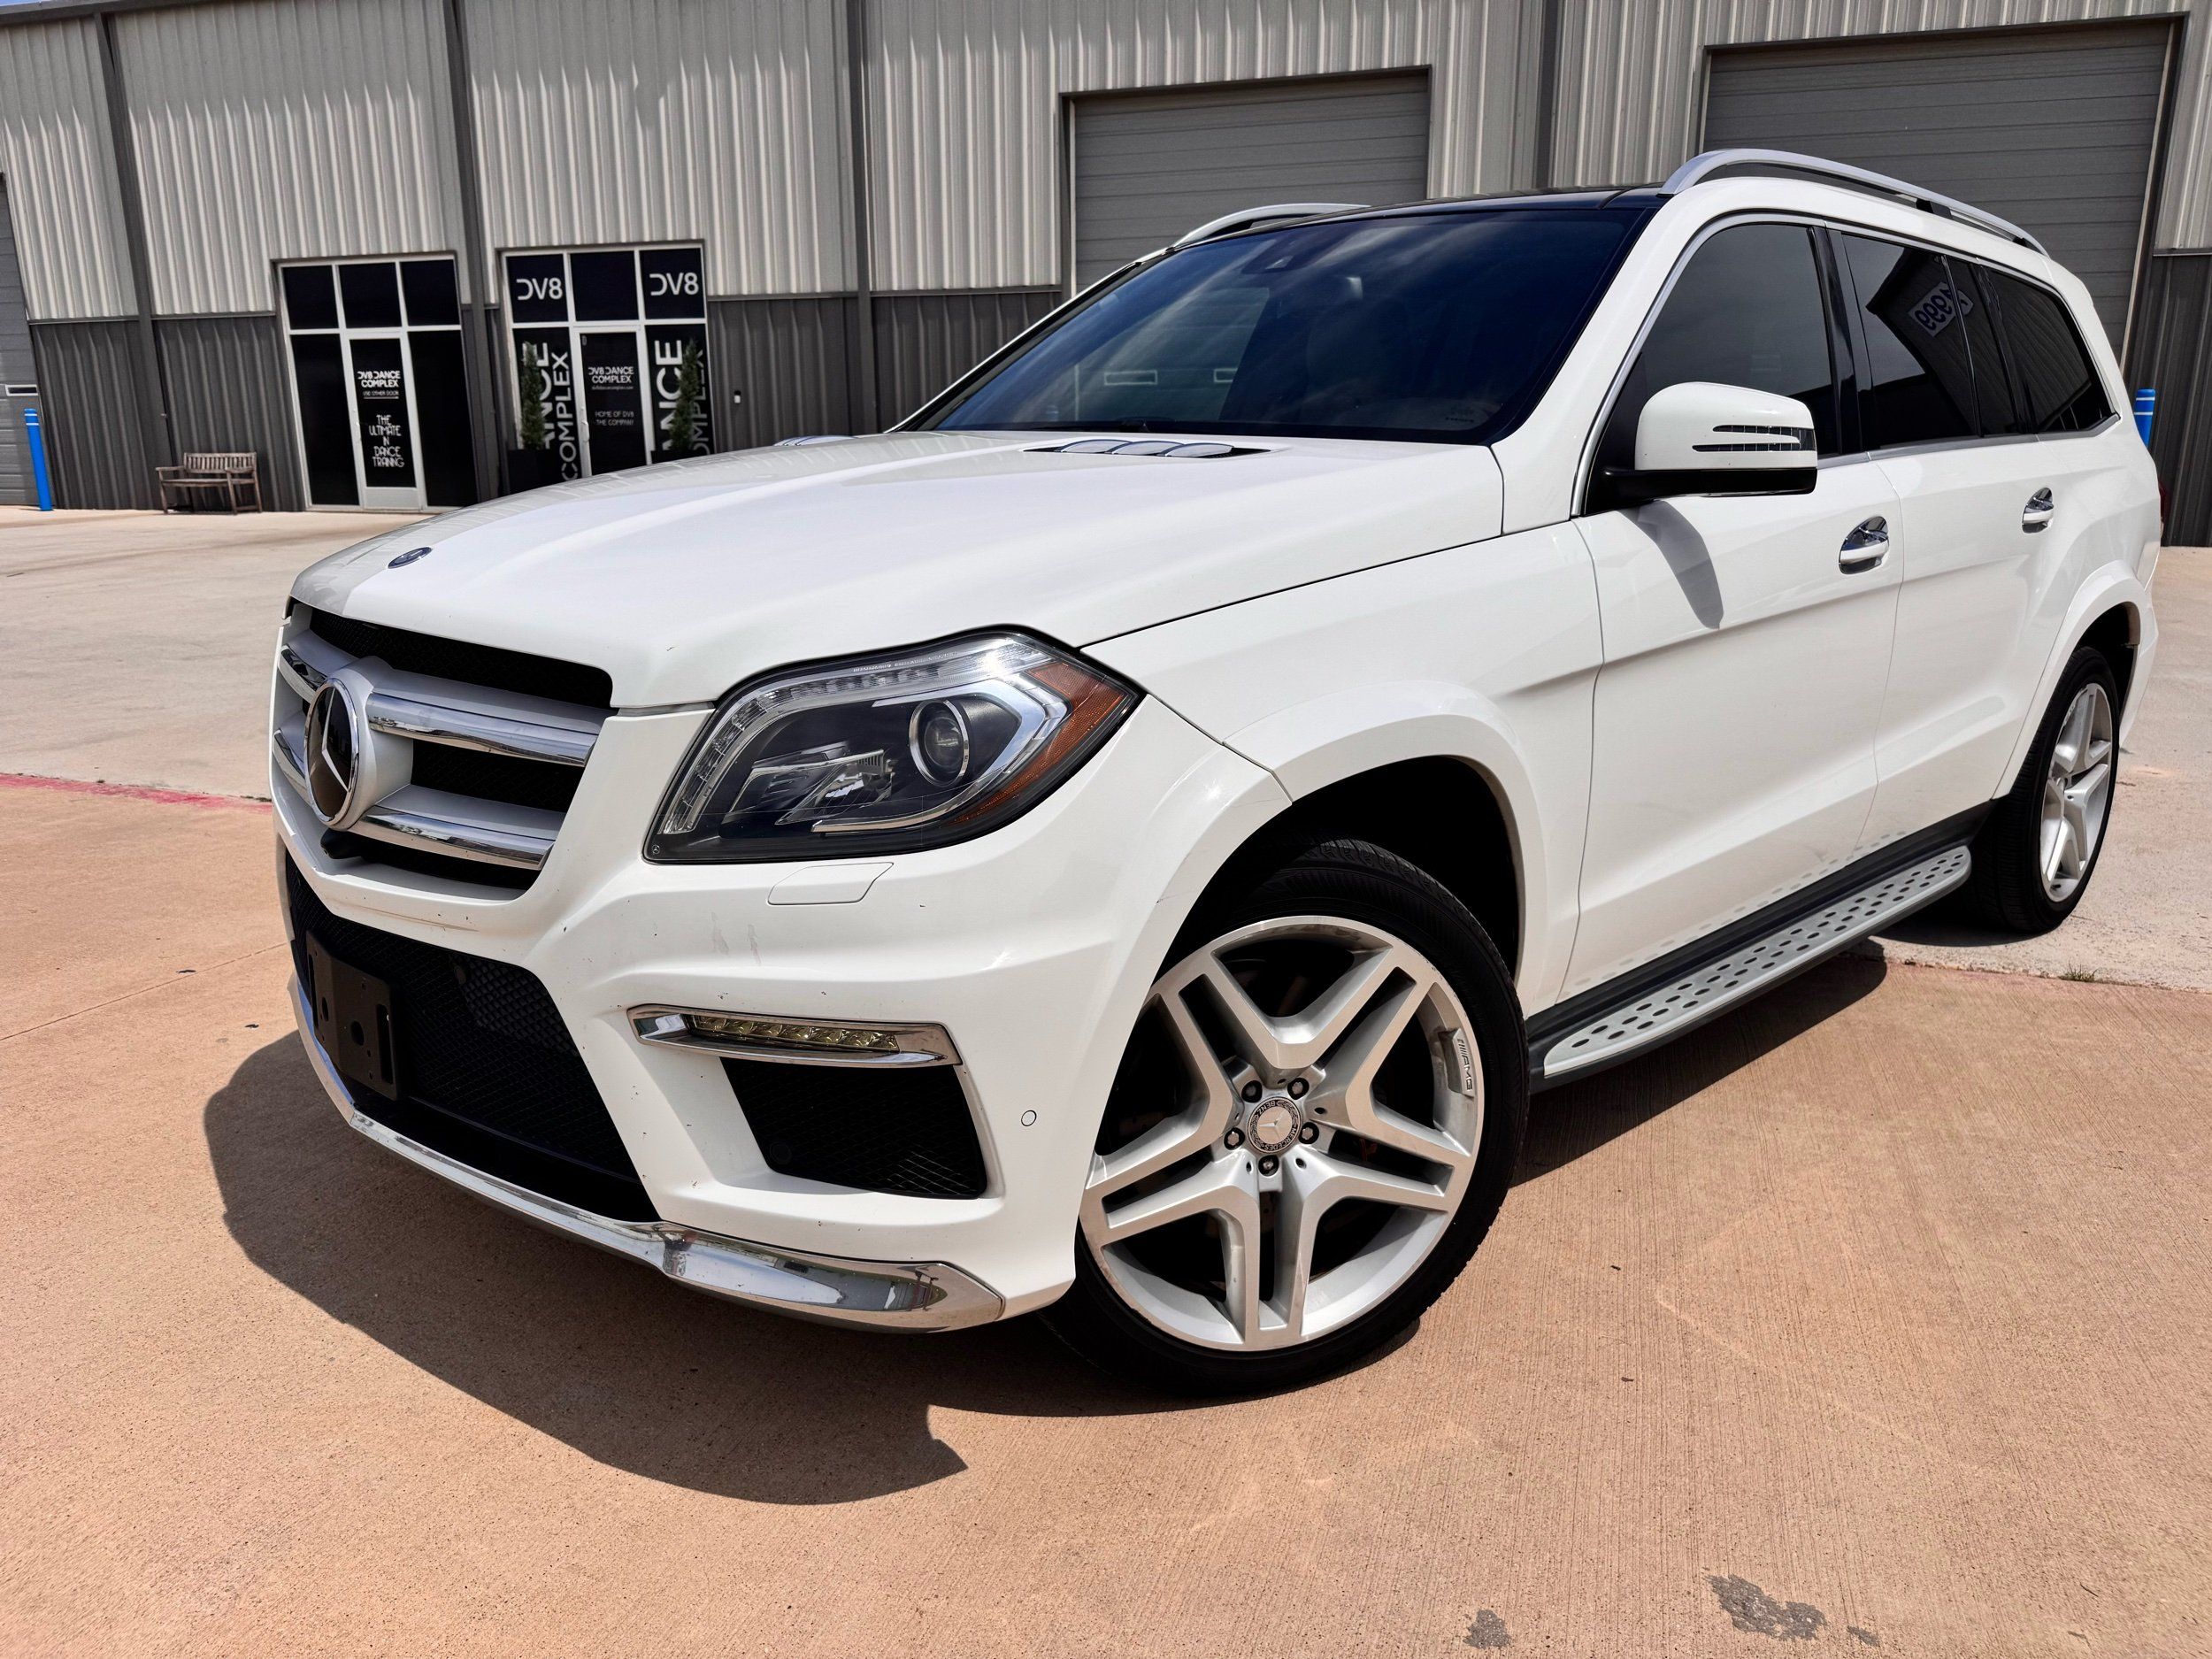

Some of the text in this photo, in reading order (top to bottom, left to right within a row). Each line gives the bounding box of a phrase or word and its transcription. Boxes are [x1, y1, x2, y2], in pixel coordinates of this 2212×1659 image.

[373, 370, 401, 380] DANCE
[604, 365, 634, 375] DANCE
[591, 375, 632, 384] COMPLEX
[376, 414, 391, 426] THE
[550, 351, 578, 480] COMPLEX
[373, 445, 401, 457] DANCE
[1256, 1100, 1298, 1151] MERCEDES BENZ
